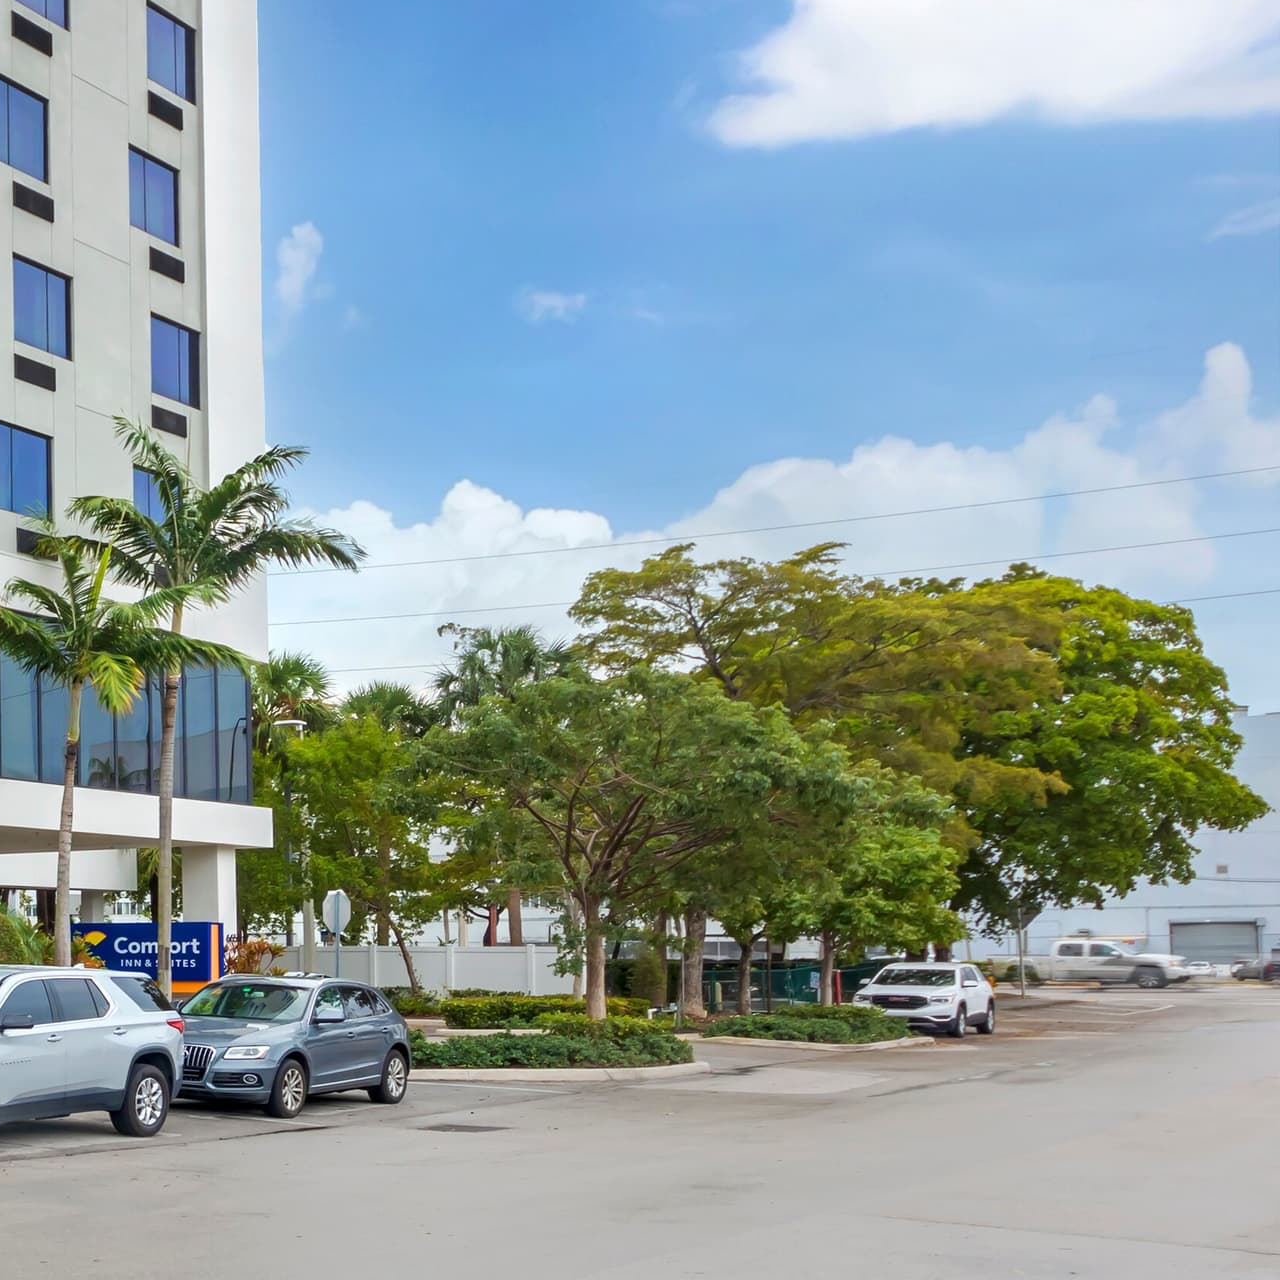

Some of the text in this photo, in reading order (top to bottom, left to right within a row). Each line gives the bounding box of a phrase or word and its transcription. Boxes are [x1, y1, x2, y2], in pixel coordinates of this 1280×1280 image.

[113, 936, 200, 954] Comort
[120, 959, 197, 968] INN & ITES
